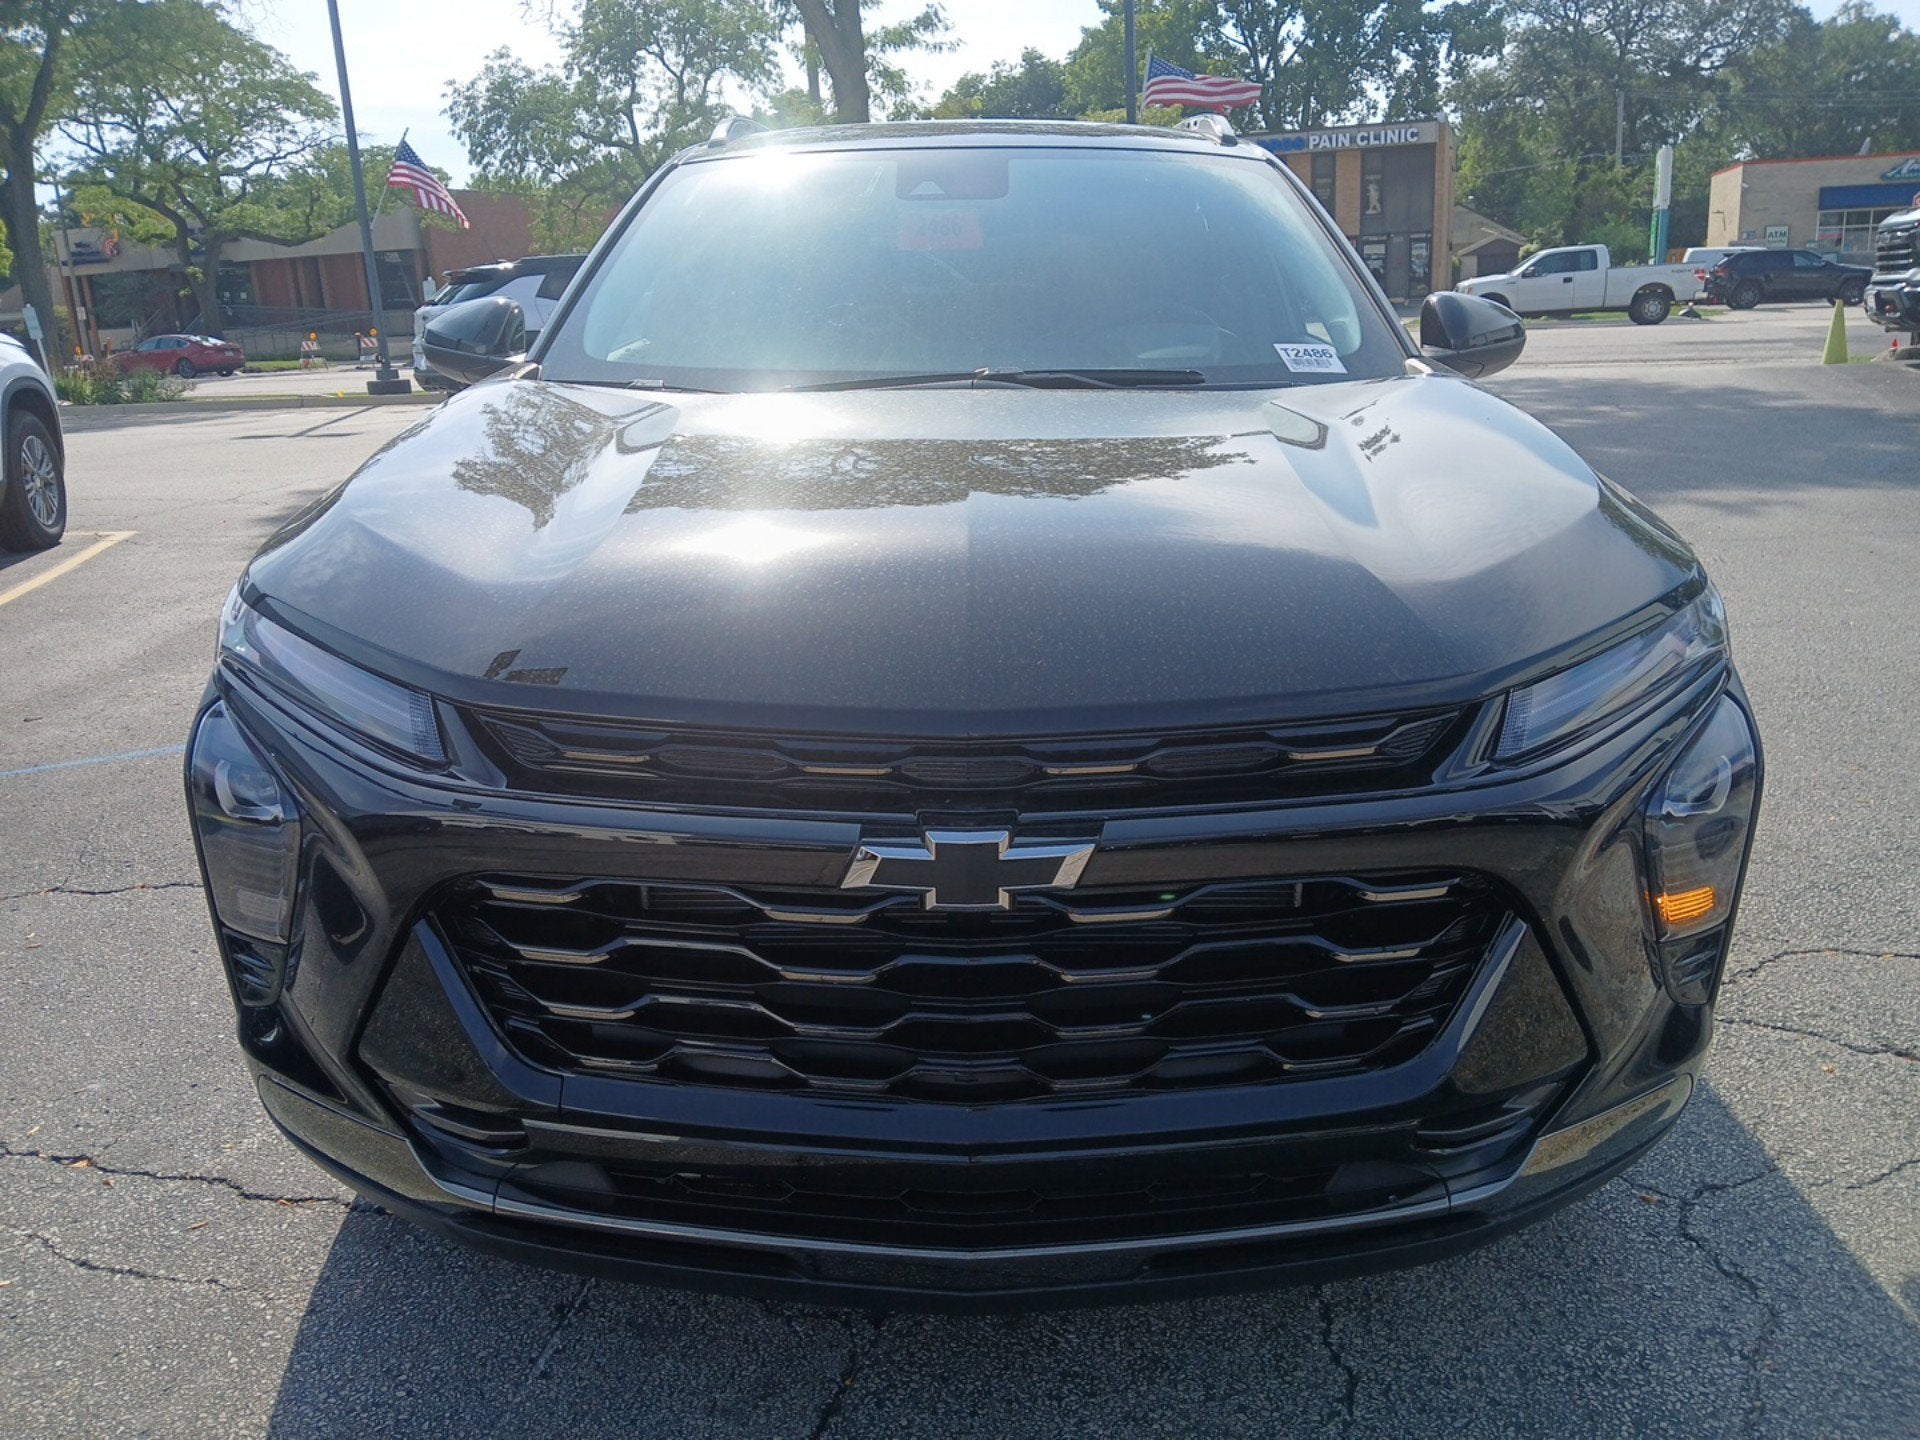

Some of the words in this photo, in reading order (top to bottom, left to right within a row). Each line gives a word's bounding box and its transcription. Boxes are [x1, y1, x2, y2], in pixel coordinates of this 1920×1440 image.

[1309, 134, 1350, 149] PAIN
[1356, 128, 1419, 145] CLINIC
[1767, 230, 1788, 239] ATM
[1280, 347, 1333, 359] T2486
